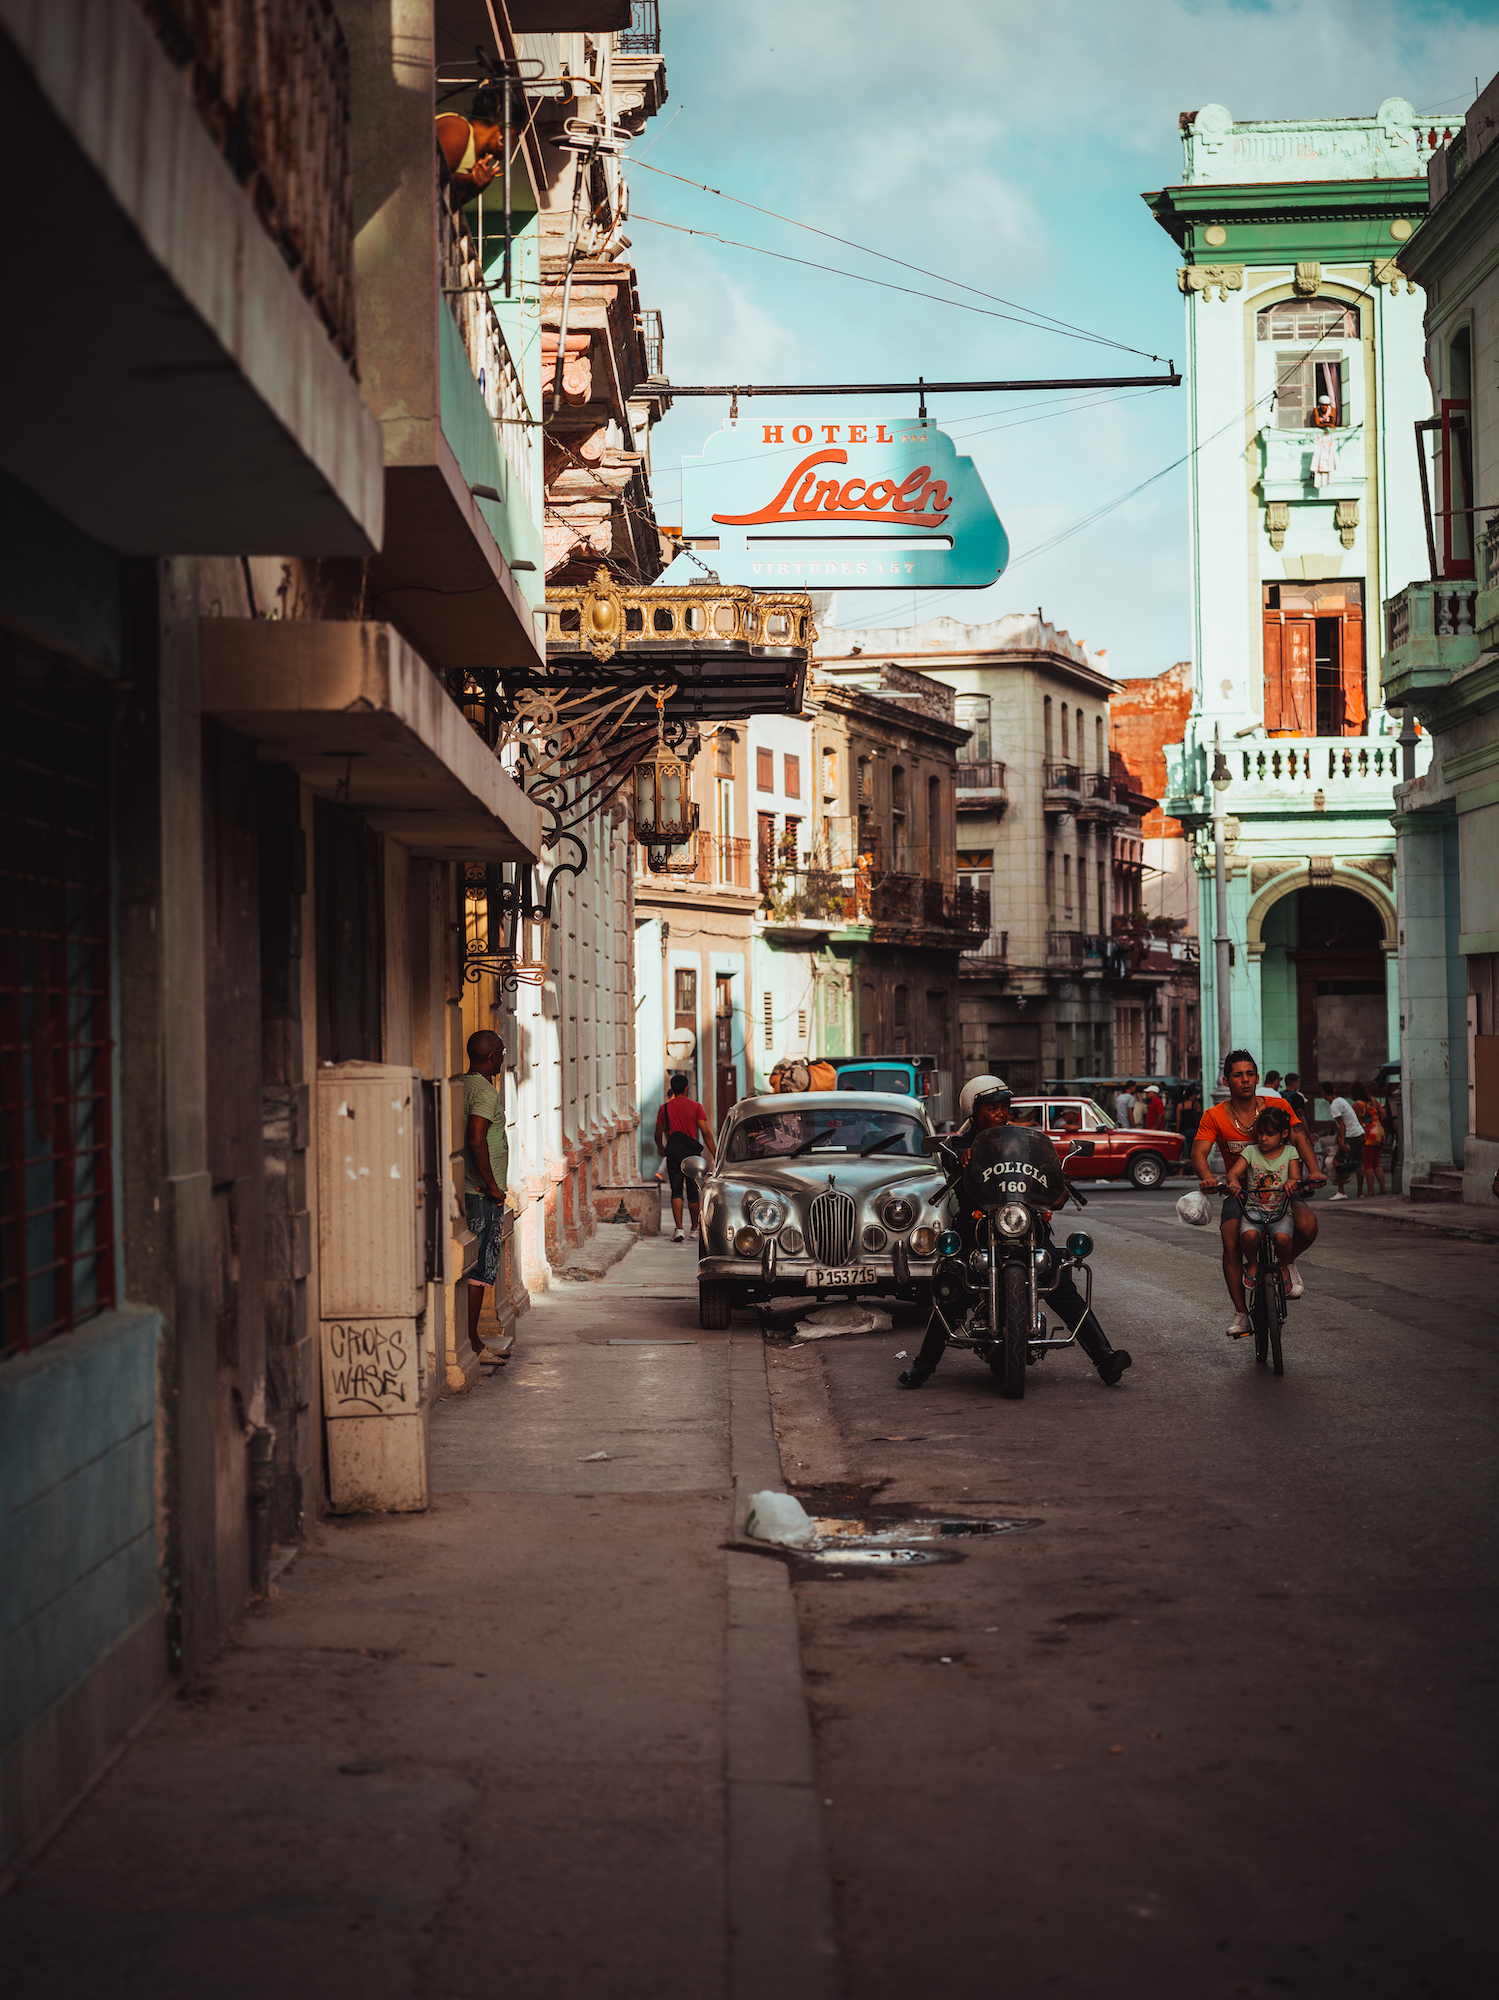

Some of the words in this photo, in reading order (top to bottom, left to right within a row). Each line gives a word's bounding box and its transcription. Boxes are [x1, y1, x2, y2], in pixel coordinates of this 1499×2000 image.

[762, 424, 894, 444] HOTEL
[711, 448, 953, 528] Lincoln
[751, 561, 869, 575] VIRTUDES
[877, 561, 916, 574] 157
[982, 1161, 1049, 1189] POLICIA
[998, 1180, 1027, 1193] 160
